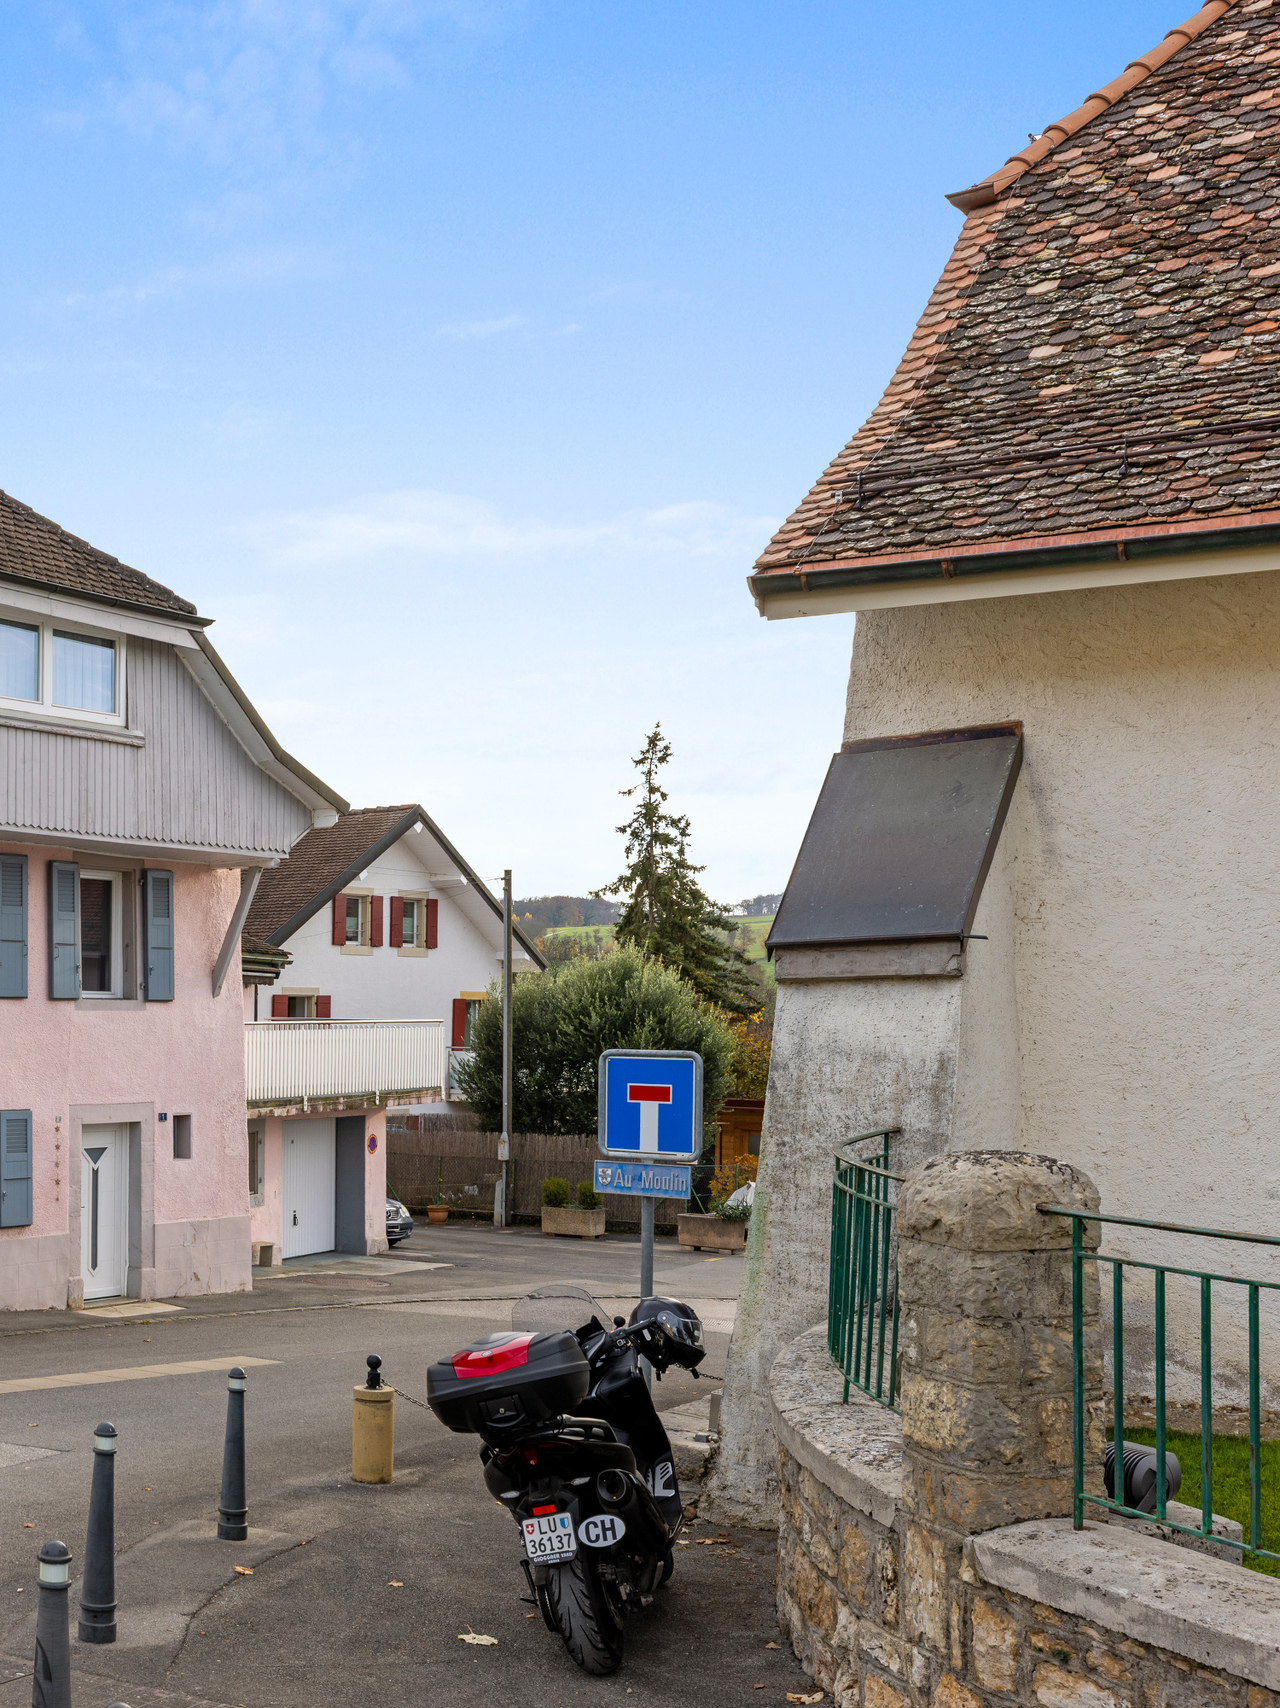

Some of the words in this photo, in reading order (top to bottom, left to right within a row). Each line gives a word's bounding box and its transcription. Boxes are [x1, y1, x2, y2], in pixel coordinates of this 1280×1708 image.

[613, 1168, 632, 1188] Au
[641, 1170, 687, 1192] Moulin
[537, 1517, 558, 1535] LU
[584, 1518, 618, 1544] CH
[528, 1533, 572, 1555] 36137
